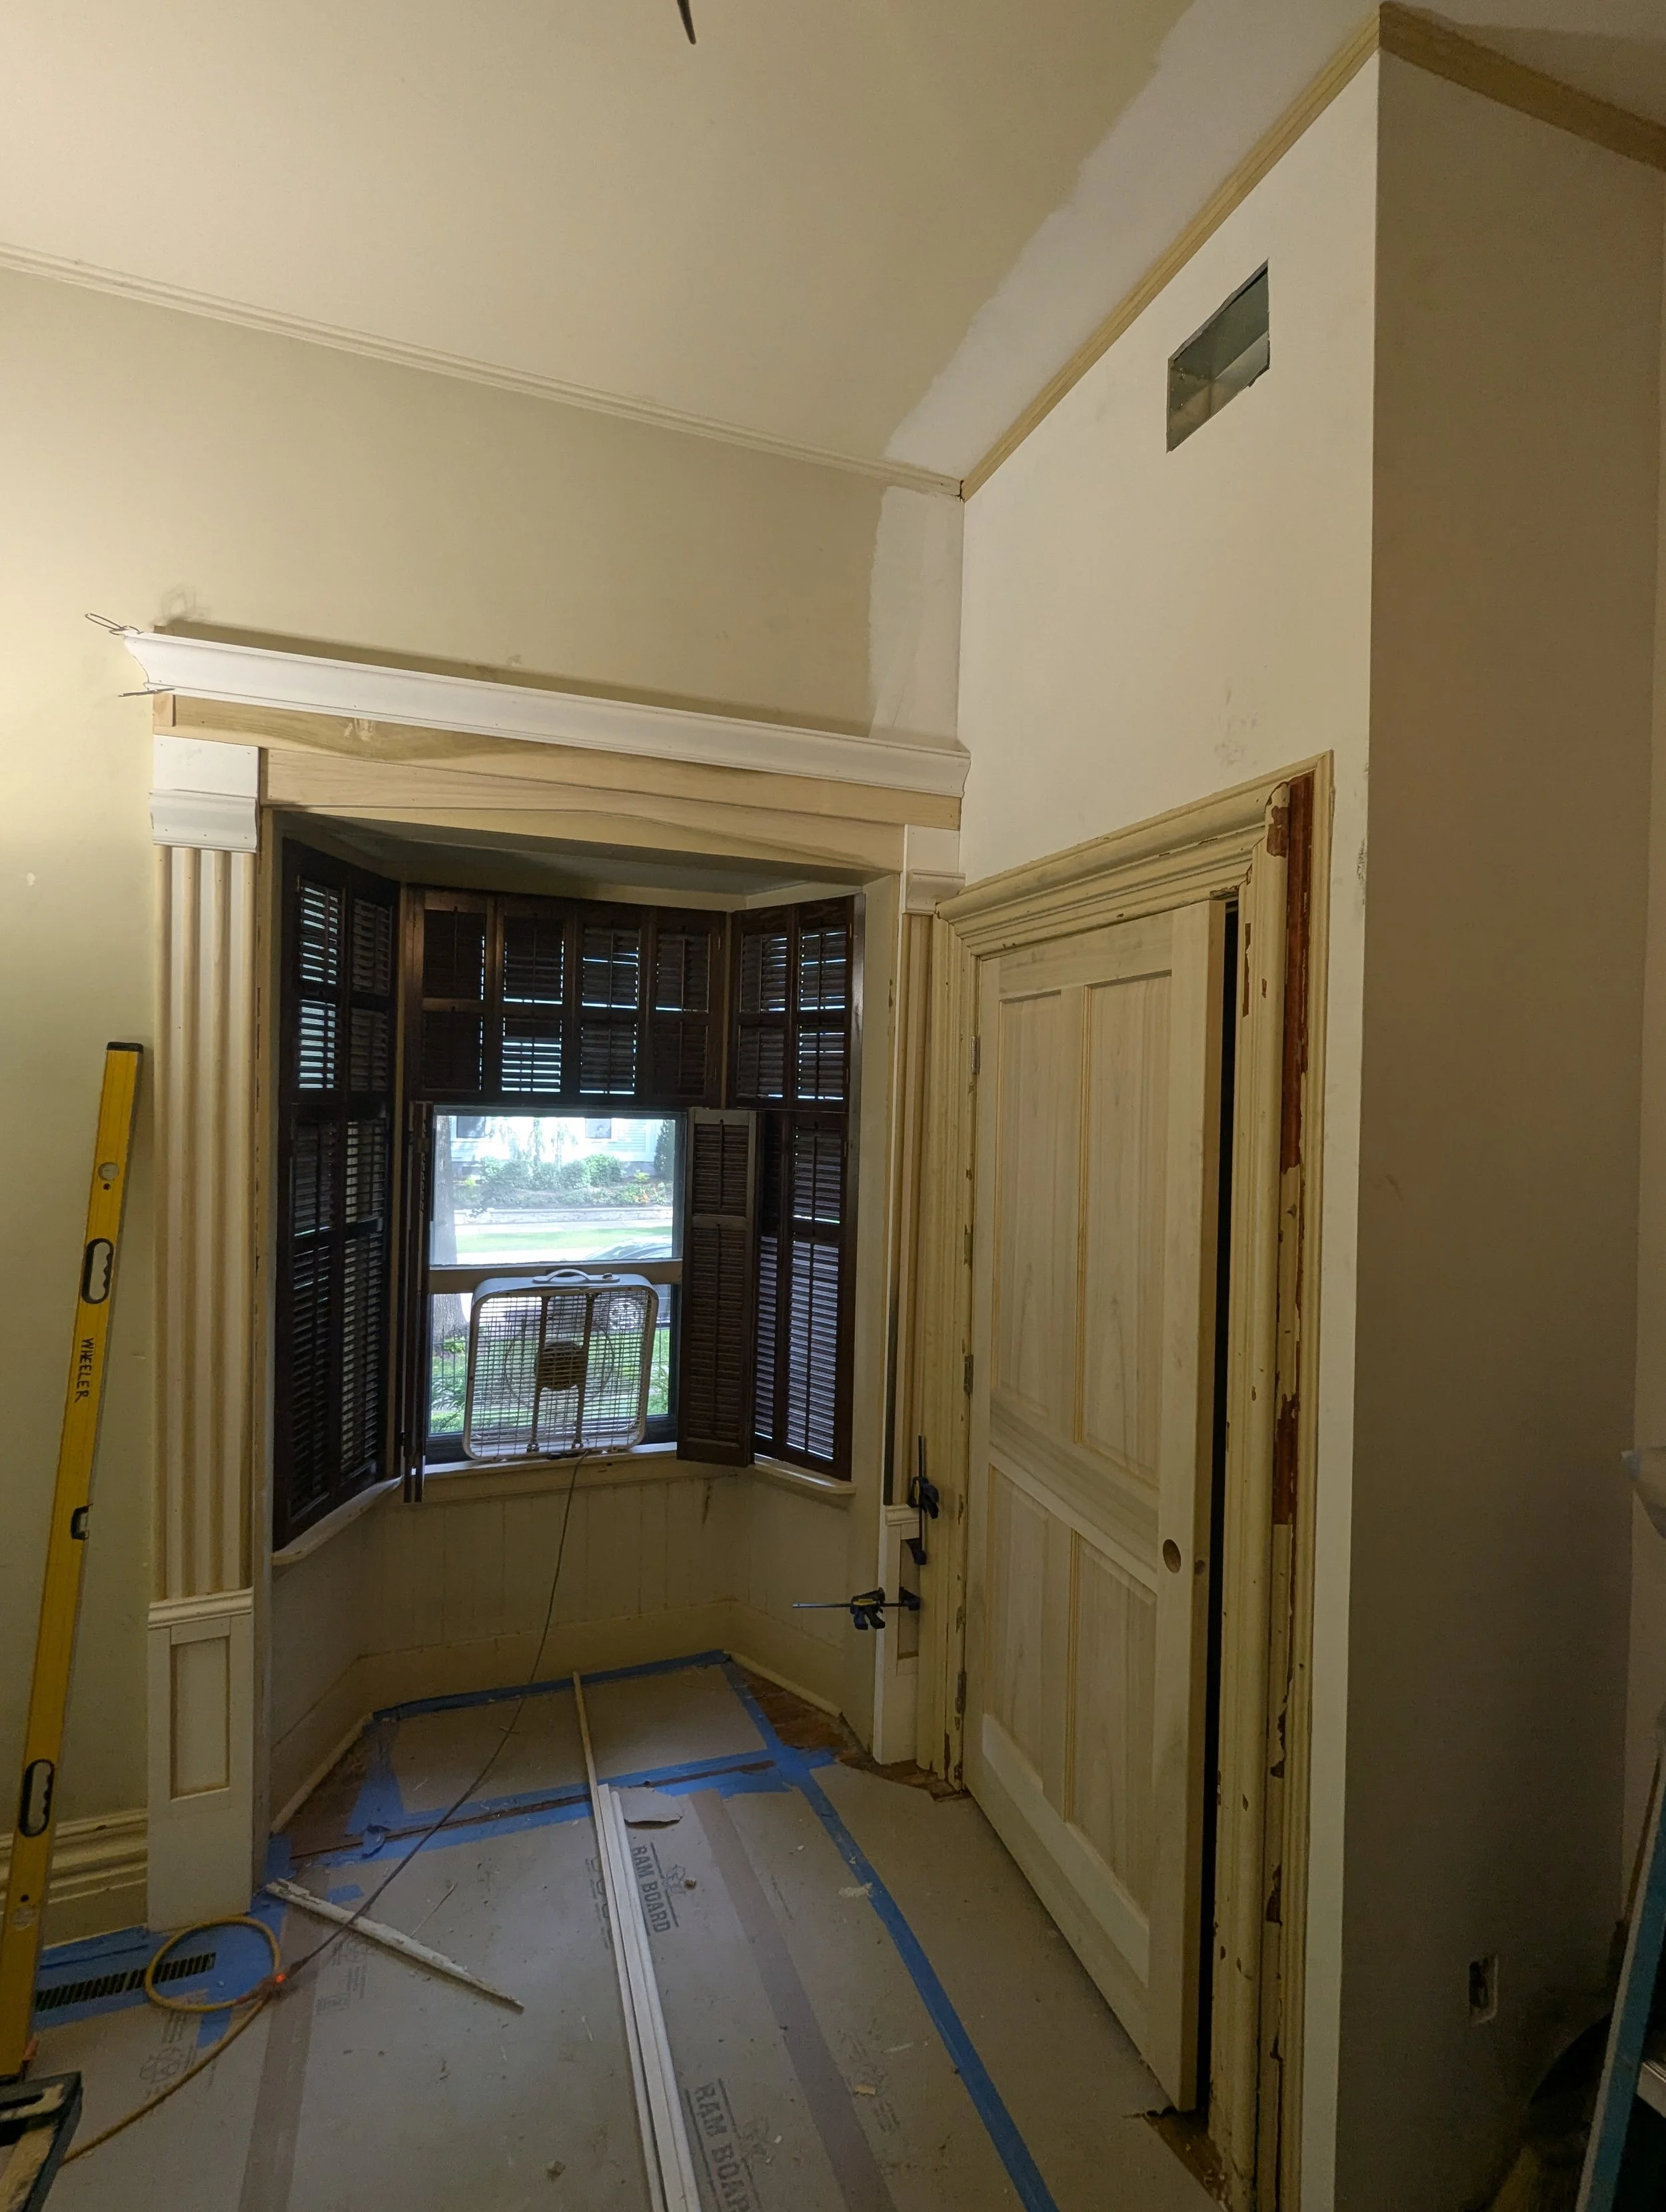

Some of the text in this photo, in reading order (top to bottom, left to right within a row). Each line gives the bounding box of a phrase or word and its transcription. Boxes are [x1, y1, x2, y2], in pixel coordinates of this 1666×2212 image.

[75, 1337, 94, 1403] WHEELER
[632, 1845, 671, 1933] RAM BOARD
[694, 2082, 727, 2137] RAM
